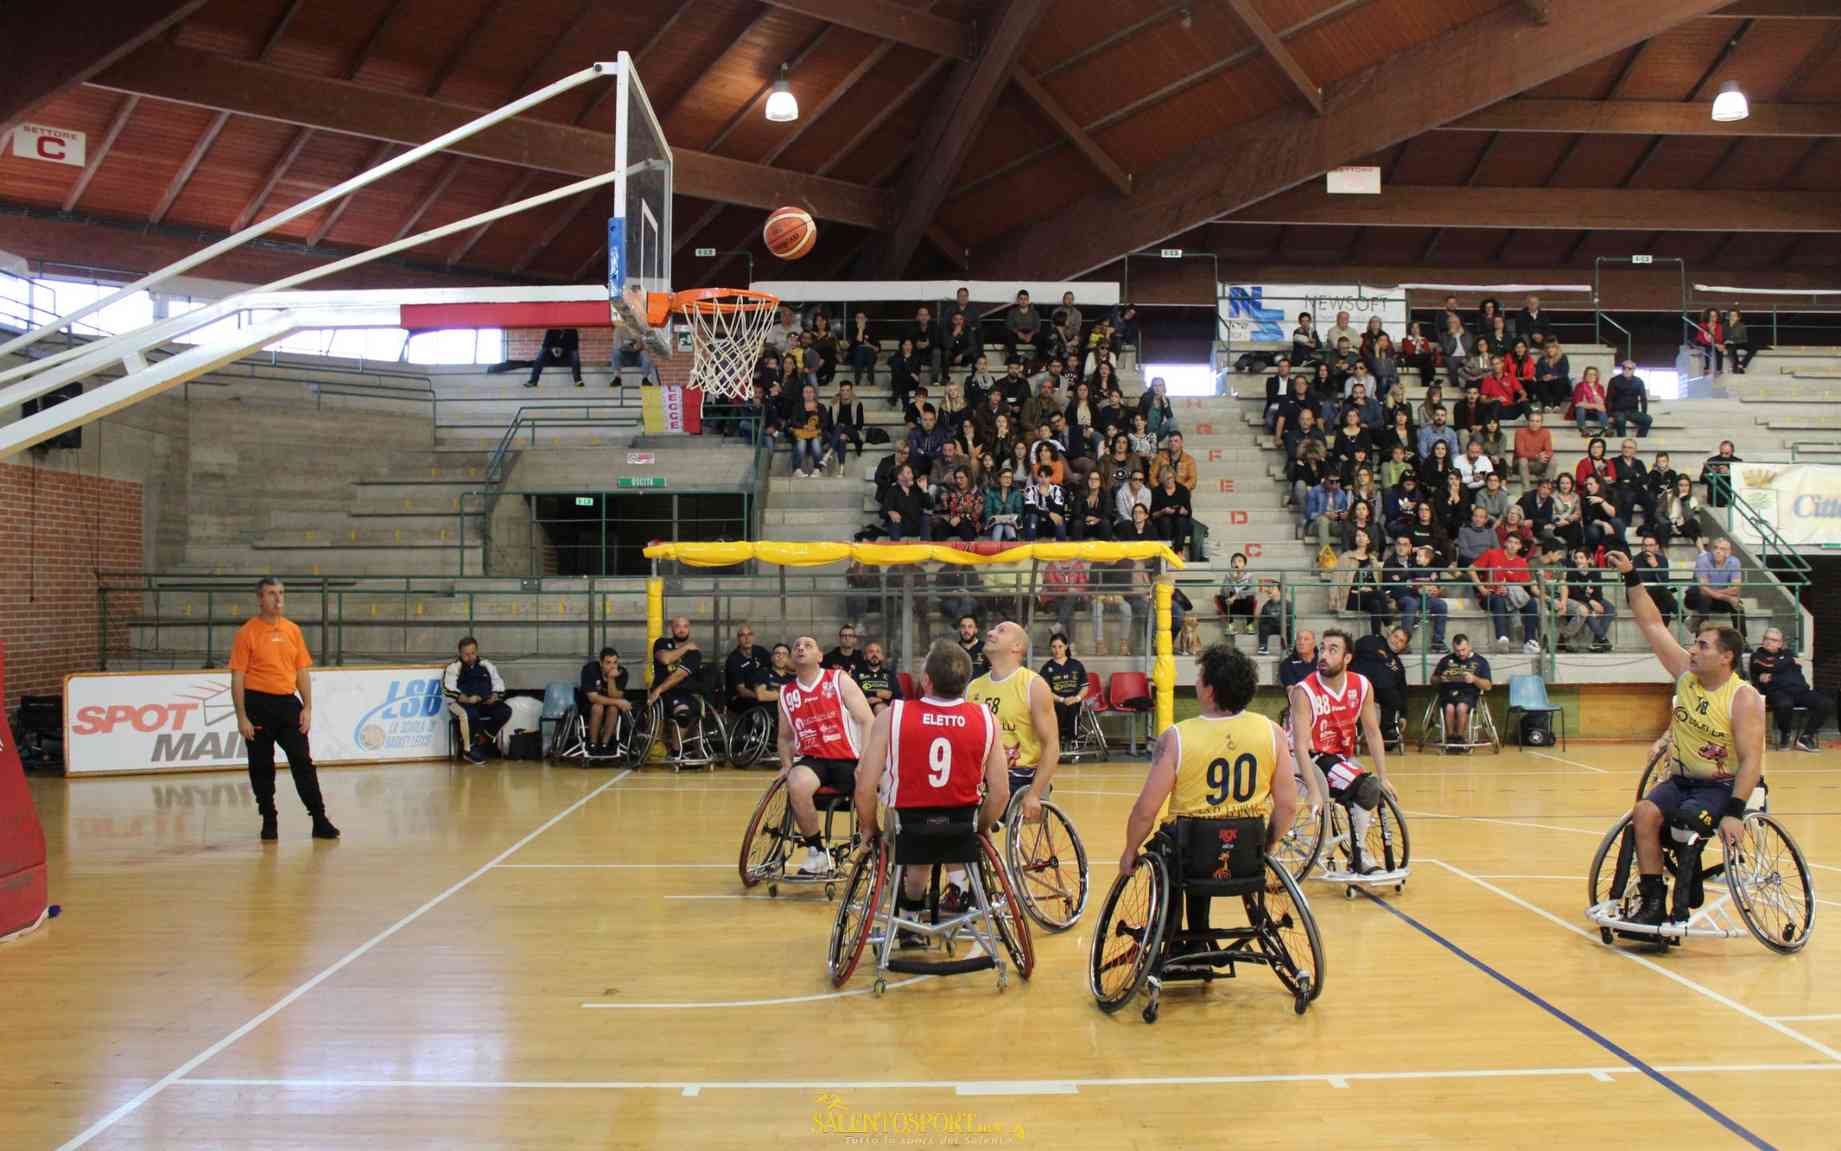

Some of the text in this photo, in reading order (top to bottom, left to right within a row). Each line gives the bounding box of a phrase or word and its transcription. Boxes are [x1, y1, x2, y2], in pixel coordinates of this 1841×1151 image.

[37, 136, 65, 160] C
[1304, 294, 1390, 312] NEWSOFT
[1209, 450, 1222, 462] F
[1220, 479, 1234, 492] E
[1793, 495, 1841, 518] Citt
[1231, 511, 1248, 524] D
[1245, 543, 1262, 557] C
[786, 689, 801, 713] 99
[72, 703, 198, 735] SPOT
[922, 712, 966, 728] ELETTO
[928, 737, 952, 788] 9
[1206, 752, 1257, 806] 90
